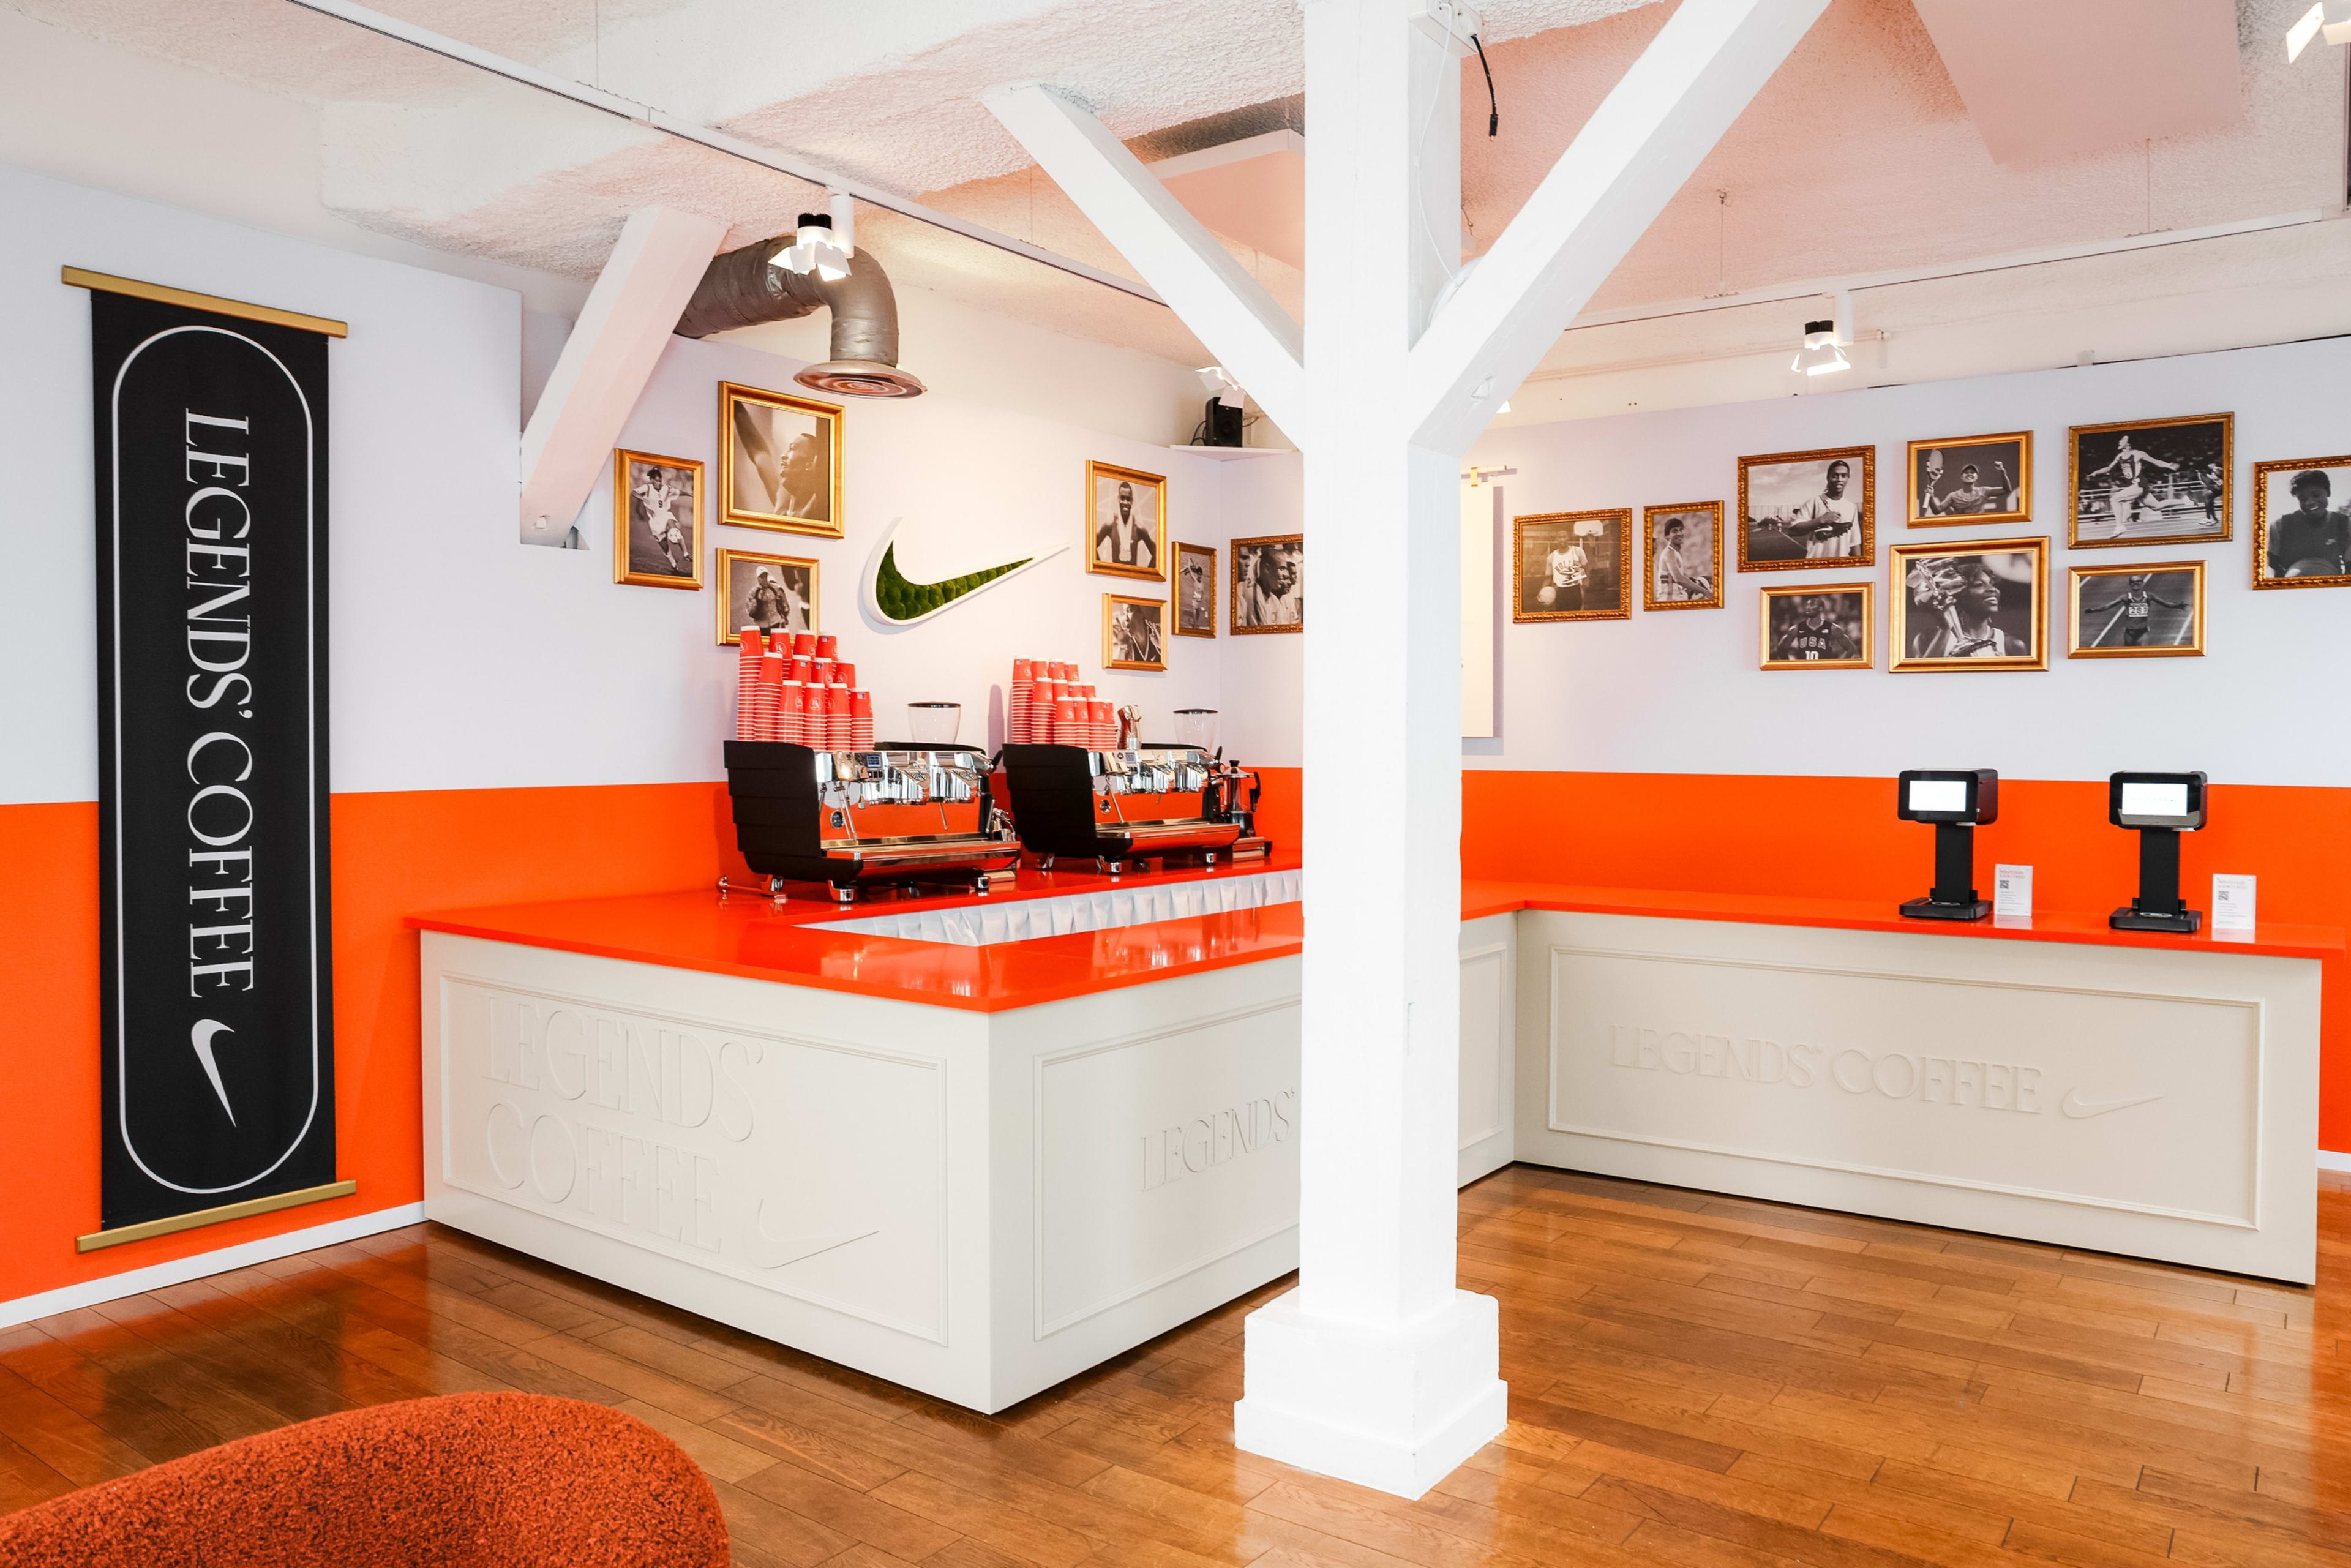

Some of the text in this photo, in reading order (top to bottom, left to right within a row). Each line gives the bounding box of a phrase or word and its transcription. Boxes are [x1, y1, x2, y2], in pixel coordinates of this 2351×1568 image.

[658, 500, 663, 508] 9
[1799, 636, 1826, 650] USA
[1805, 650, 1819, 661] 10
[184, 407, 255, 999] LEGENDS’ COFFEE
[481, 993, 765, 1142] LEGENDS’
[1610, 1023, 2045, 1116] LEGENDS’ COFFEE
[486, 1101, 722, 1255] COFFEE
